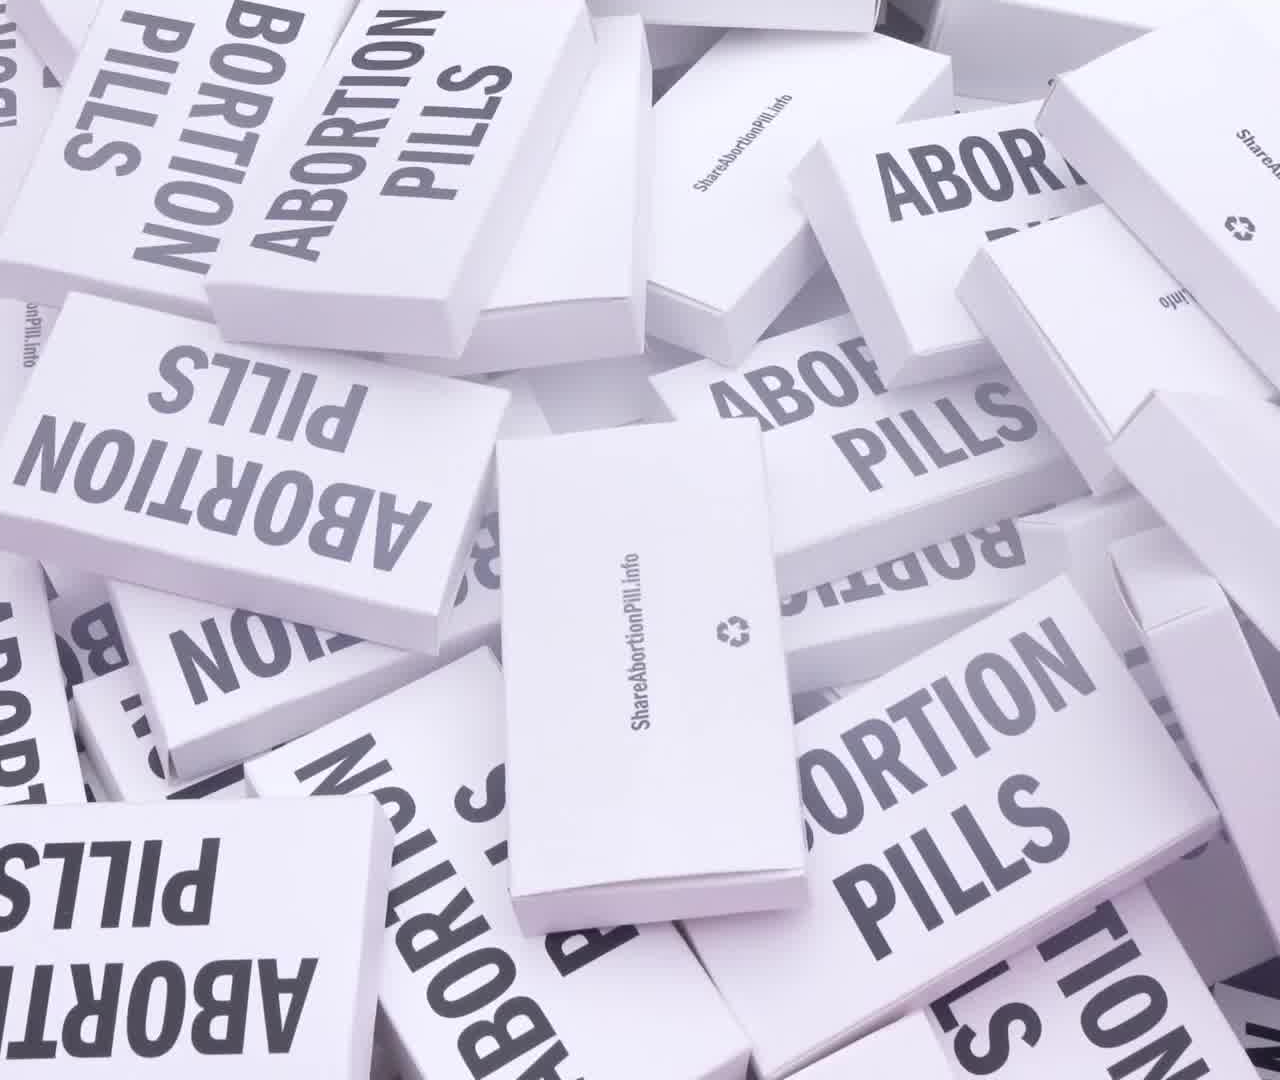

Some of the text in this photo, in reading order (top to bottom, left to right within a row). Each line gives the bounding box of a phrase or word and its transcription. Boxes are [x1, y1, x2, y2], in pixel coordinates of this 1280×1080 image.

[63, 9, 196, 177] PILLS
[250, 9, 447, 264] ABORTION
[380, 63, 513, 201] PILLS
[691, 91, 793, 194] ShareAbortionPill.info
[147, 345, 370, 454] PILLS
[832, 381, 1039, 493] PILLS
[12, 414, 433, 572] ABORTION
[618, 552, 651, 732] ShareAbortionPill.info
[796, 616, 1098, 854] ORTION
[831, 773, 1072, 963] PILLS
